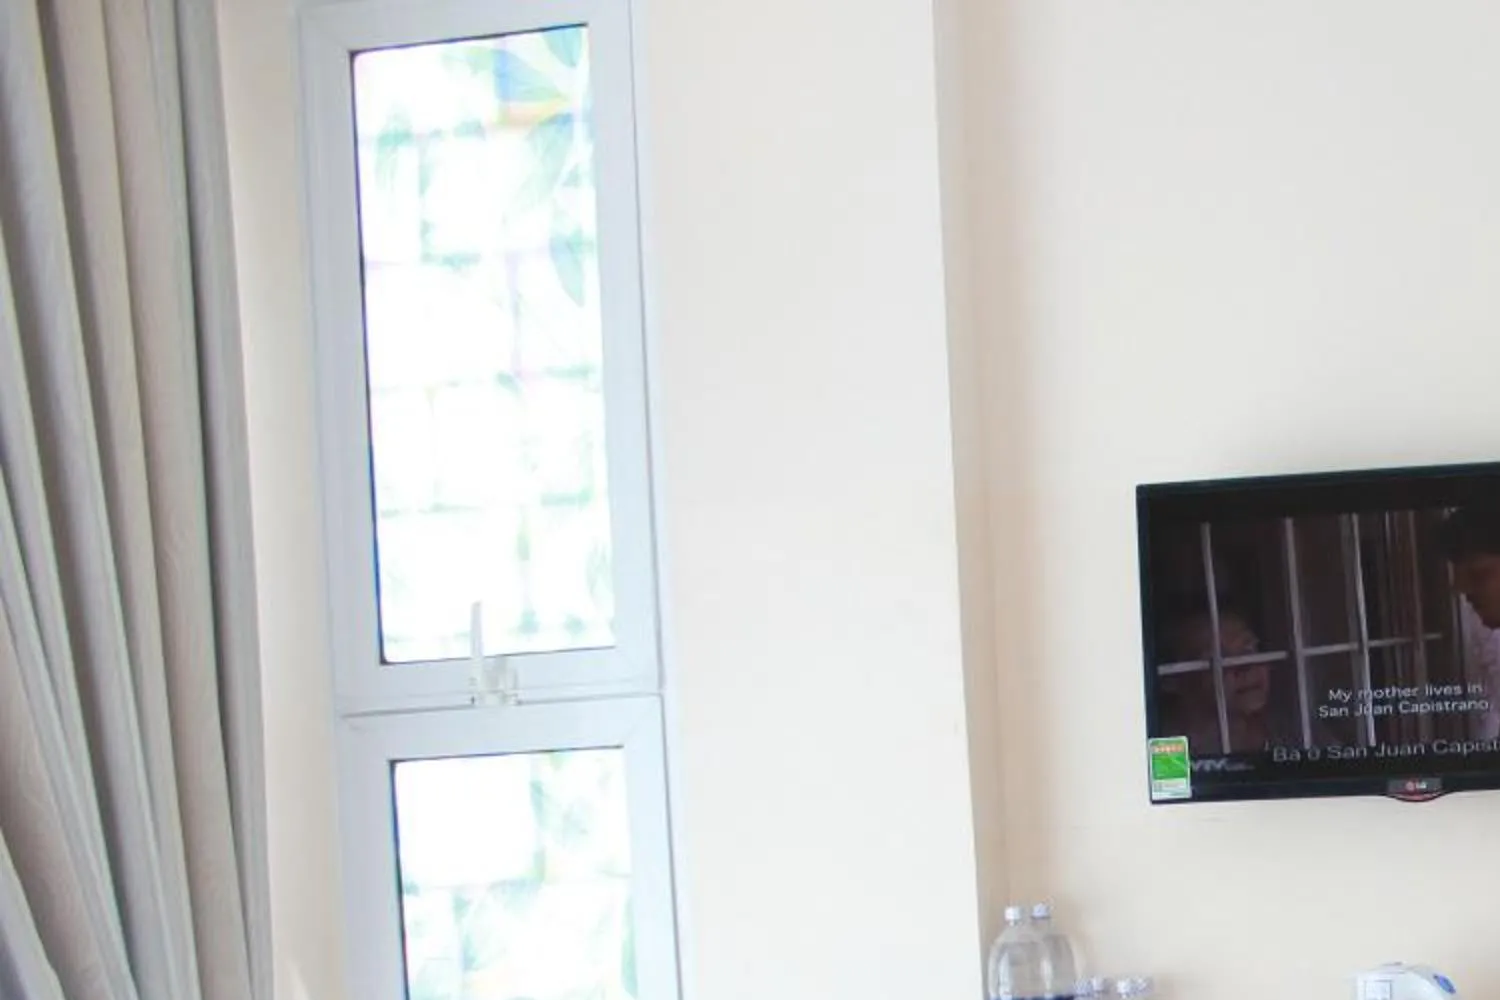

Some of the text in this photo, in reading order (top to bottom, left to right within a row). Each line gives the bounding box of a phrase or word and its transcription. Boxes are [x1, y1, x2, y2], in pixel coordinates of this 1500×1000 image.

[1328, 682, 1483, 703] My mother lives in
[1318, 704, 1350, 719] San
[1355, 702, 1393, 716] Juan
[1326, 745, 1367, 760] San
[1374, 742, 1426, 757] Juan
